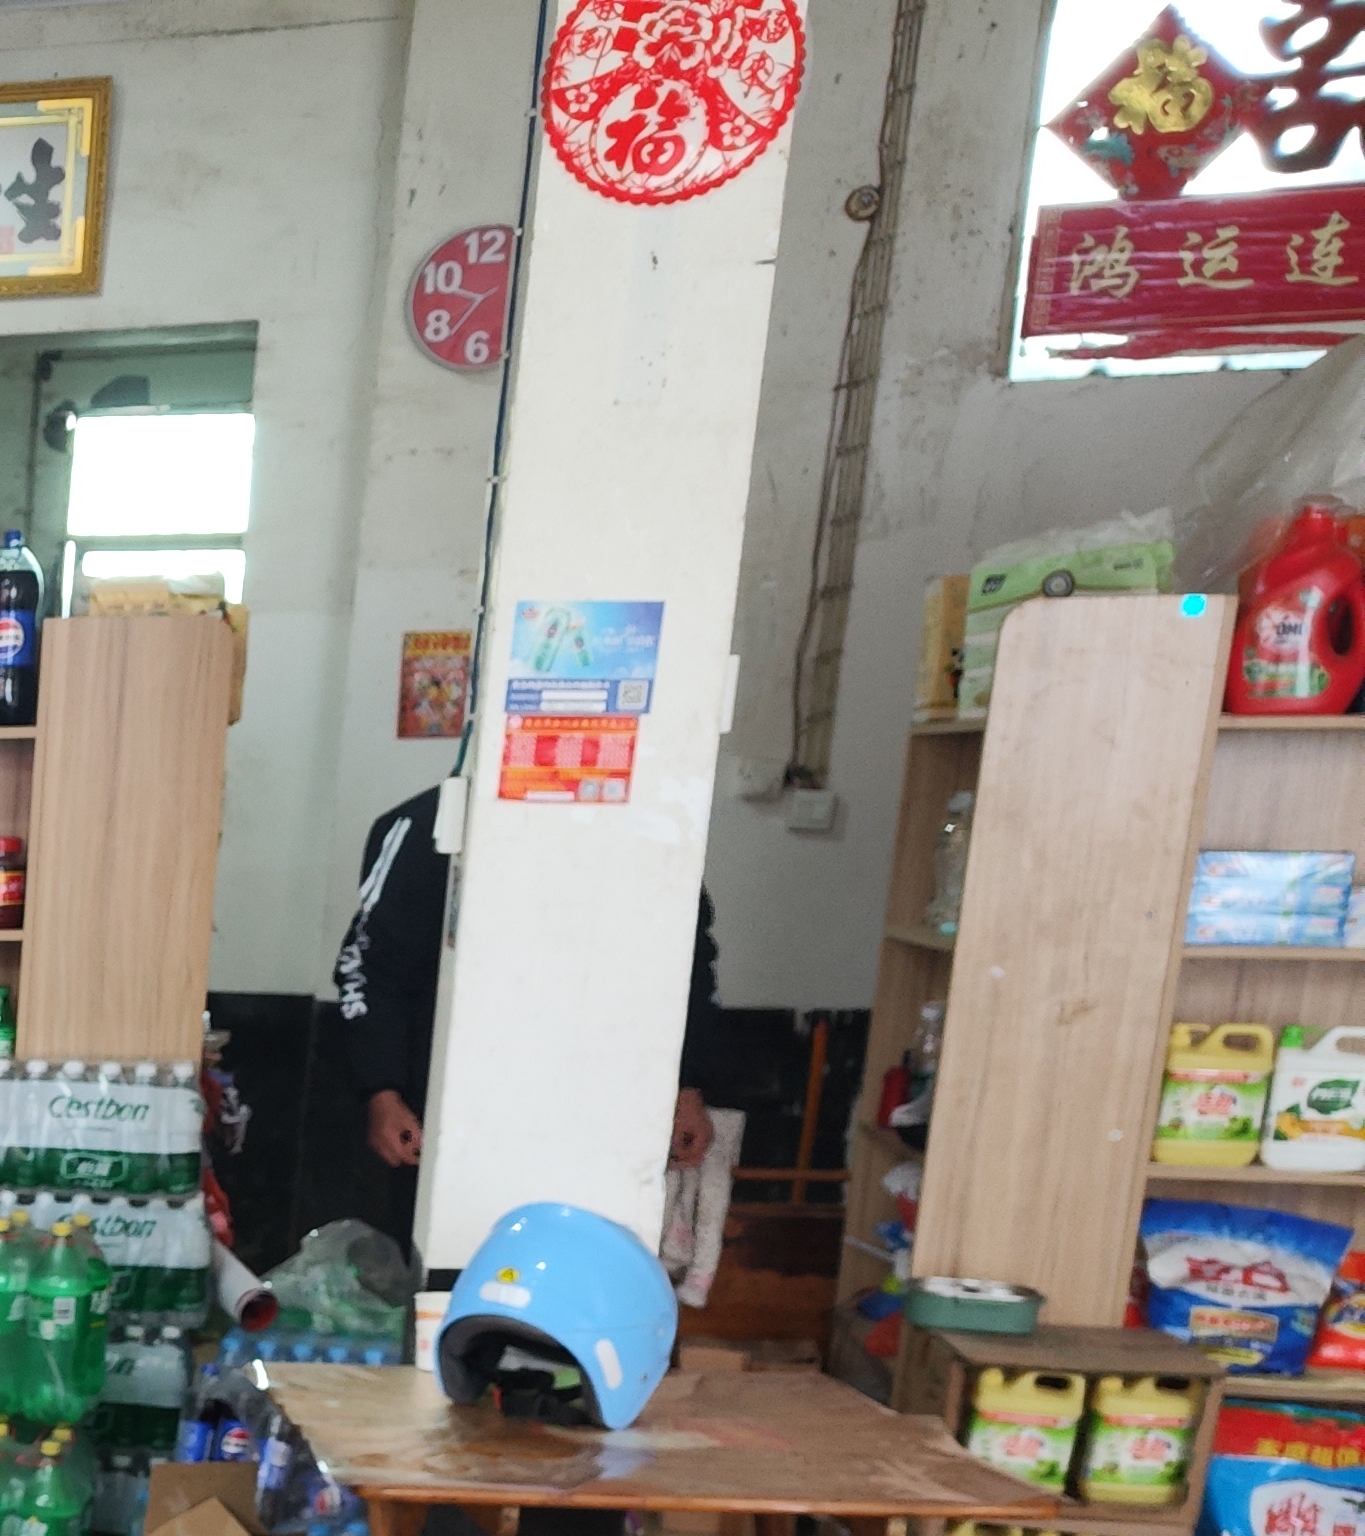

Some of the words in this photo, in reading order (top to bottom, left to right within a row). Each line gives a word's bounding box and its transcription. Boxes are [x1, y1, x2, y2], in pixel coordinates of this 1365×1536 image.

[465, 229, 506, 264] 12
[1069, 210, 1360, 299] 鸿运连
[424, 260, 463, 295] 10
[424, 308, 451, 342] 8
[464, 330, 490, 364] 6
